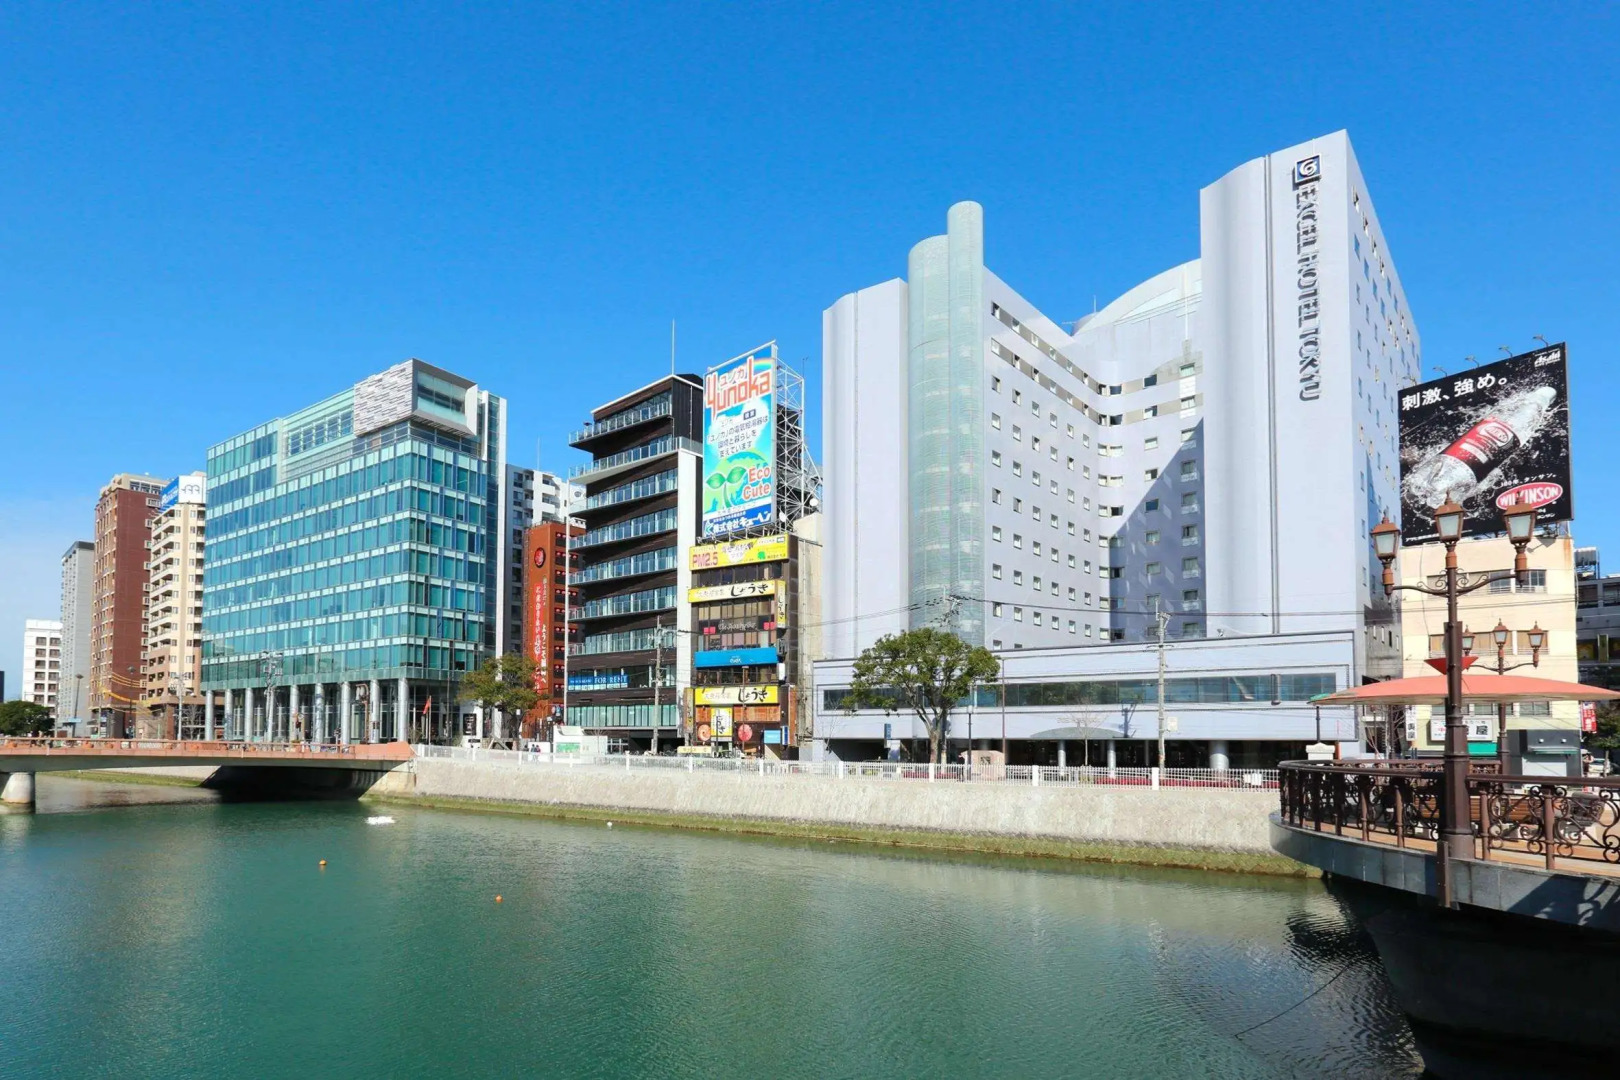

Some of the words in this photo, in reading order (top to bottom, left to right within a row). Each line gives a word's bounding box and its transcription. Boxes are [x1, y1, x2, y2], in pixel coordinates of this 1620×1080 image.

[1296, 184, 1319, 254] EXCEL
[1297, 250, 1319, 328] HOTEL
[1299, 327, 1320, 401] TOKYU
[1402, 373, 1508, 411] 刺激、強め。
[748, 466, 771, 482] Eco
[743, 484, 770, 500] Cute
[692, 551, 719, 568] PM2.5
[594, 676, 607, 684] FOR
[609, 674, 628, 684] RENT
